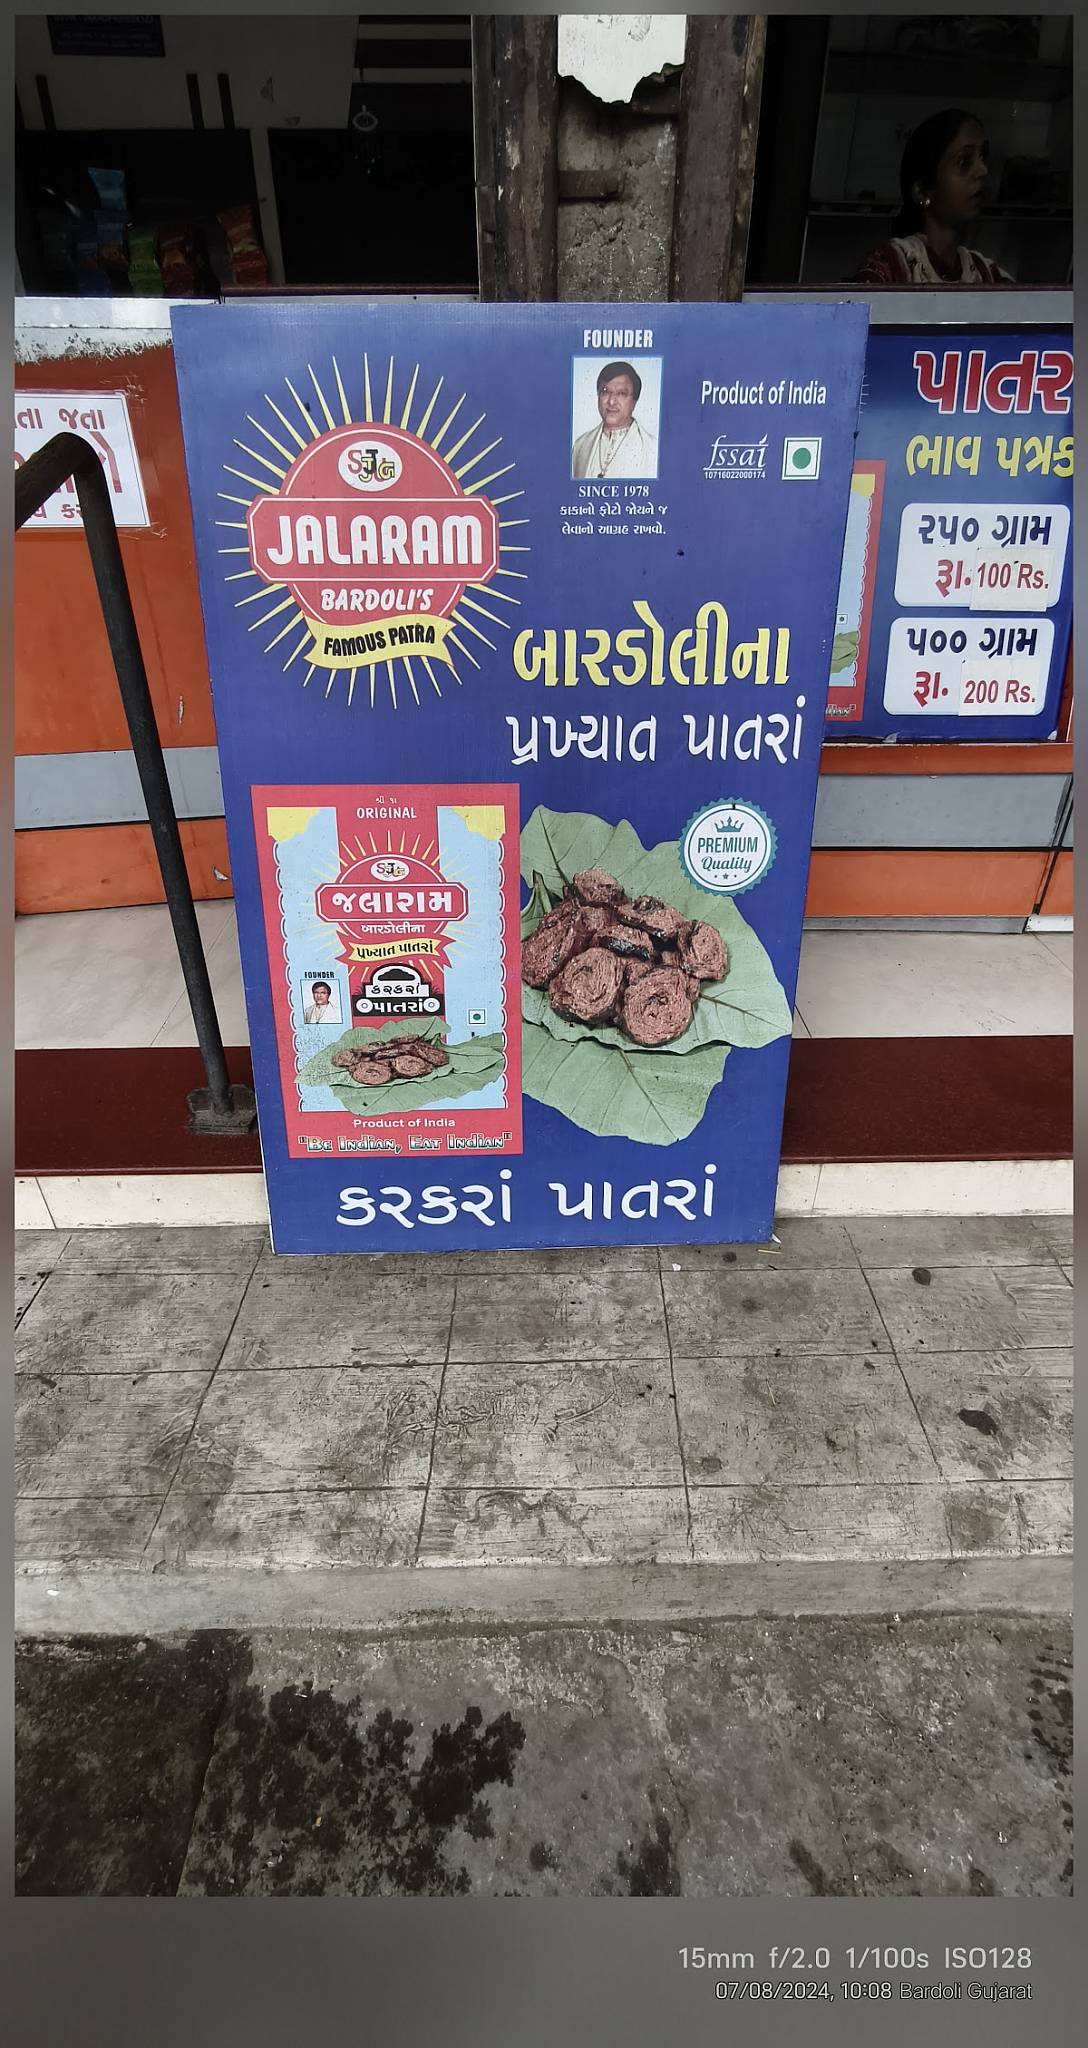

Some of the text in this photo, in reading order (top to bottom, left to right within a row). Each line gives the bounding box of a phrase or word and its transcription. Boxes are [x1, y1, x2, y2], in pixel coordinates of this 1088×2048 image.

[583, 329, 654, 348] FOUNDER
[701, 380, 827, 405] Product of India
[14, 408, 105, 430] તા જતા
[703, 433, 769, 469] fssai
[906, 435, 982, 476] ભાવ
[578, 485, 650, 498] SINCE 1978
[560, 502, 595, 515] કાકાનો
[599, 502, 621, 517] ફોટો
[658, 506, 668, 515] જ
[561, 521, 594, 534] લેવાનો
[633, 521, 667, 535] રાખવો.
[918, 514, 1053, 549] ૨૫૦ ગ્રામ
[267, 515, 483, 565] JALARAM
[977, 562, 1012, 589] 100
[1017, 562, 1050, 589] Rs.
[321, 588, 434, 613] BARDOLI'S
[323, 623, 436, 657] FAMOUS PATRA
[512, 600, 791, 687] બારડોલીના
[907, 627, 1038, 659] ૫૦૦ ગ્રામ
[963, 680, 999, 704] 200
[1004, 679, 1036, 703] Rs.
[505, 695, 806, 765] પ્રખ્યાત પાતરાં
[356, 806, 418, 819] ORIGINAL
[697, 837, 759, 853] PREMIUM
[701, 856, 752, 873] Quality
[332, 891, 451, 914] જલારામ
[361, 921, 426, 934] બારડોલીના
[356, 940, 433, 959] પ્રખ્યાત પાતરાં
[304, 971, 335, 979] FOUNDER
[371, 982, 420, 995] કરકરાં
[373, 998, 424, 1013] પાતરાં
[353, 1118, 456, 1129] Product of India
[336, 1163, 718, 1228] કરકરાં પાતરાં
